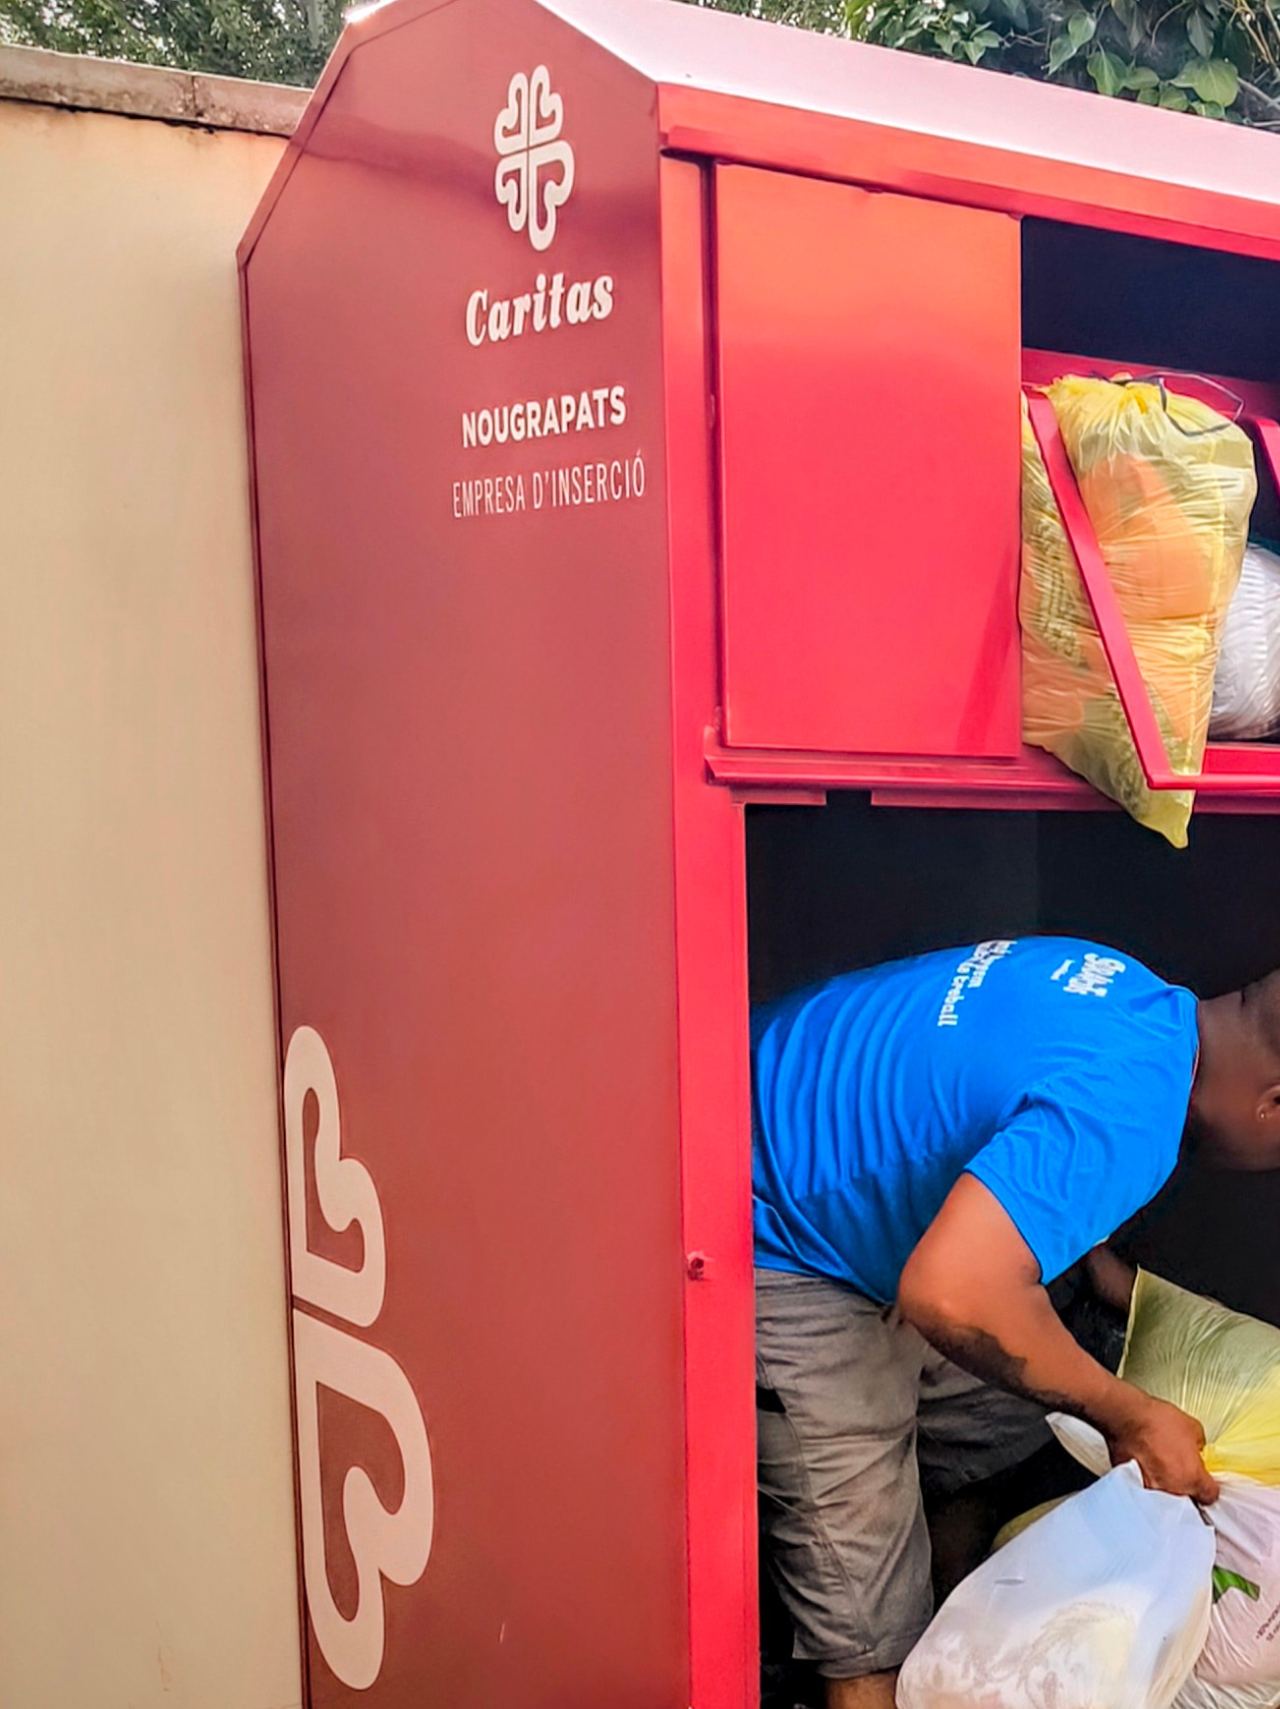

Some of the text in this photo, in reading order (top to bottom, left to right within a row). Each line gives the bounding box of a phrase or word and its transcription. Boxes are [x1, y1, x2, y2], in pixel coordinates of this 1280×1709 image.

[466, 272, 614, 346] Caritas
[462, 385, 626, 448] NOUGRAPATS
[453, 475, 526, 518] EMPRESA
